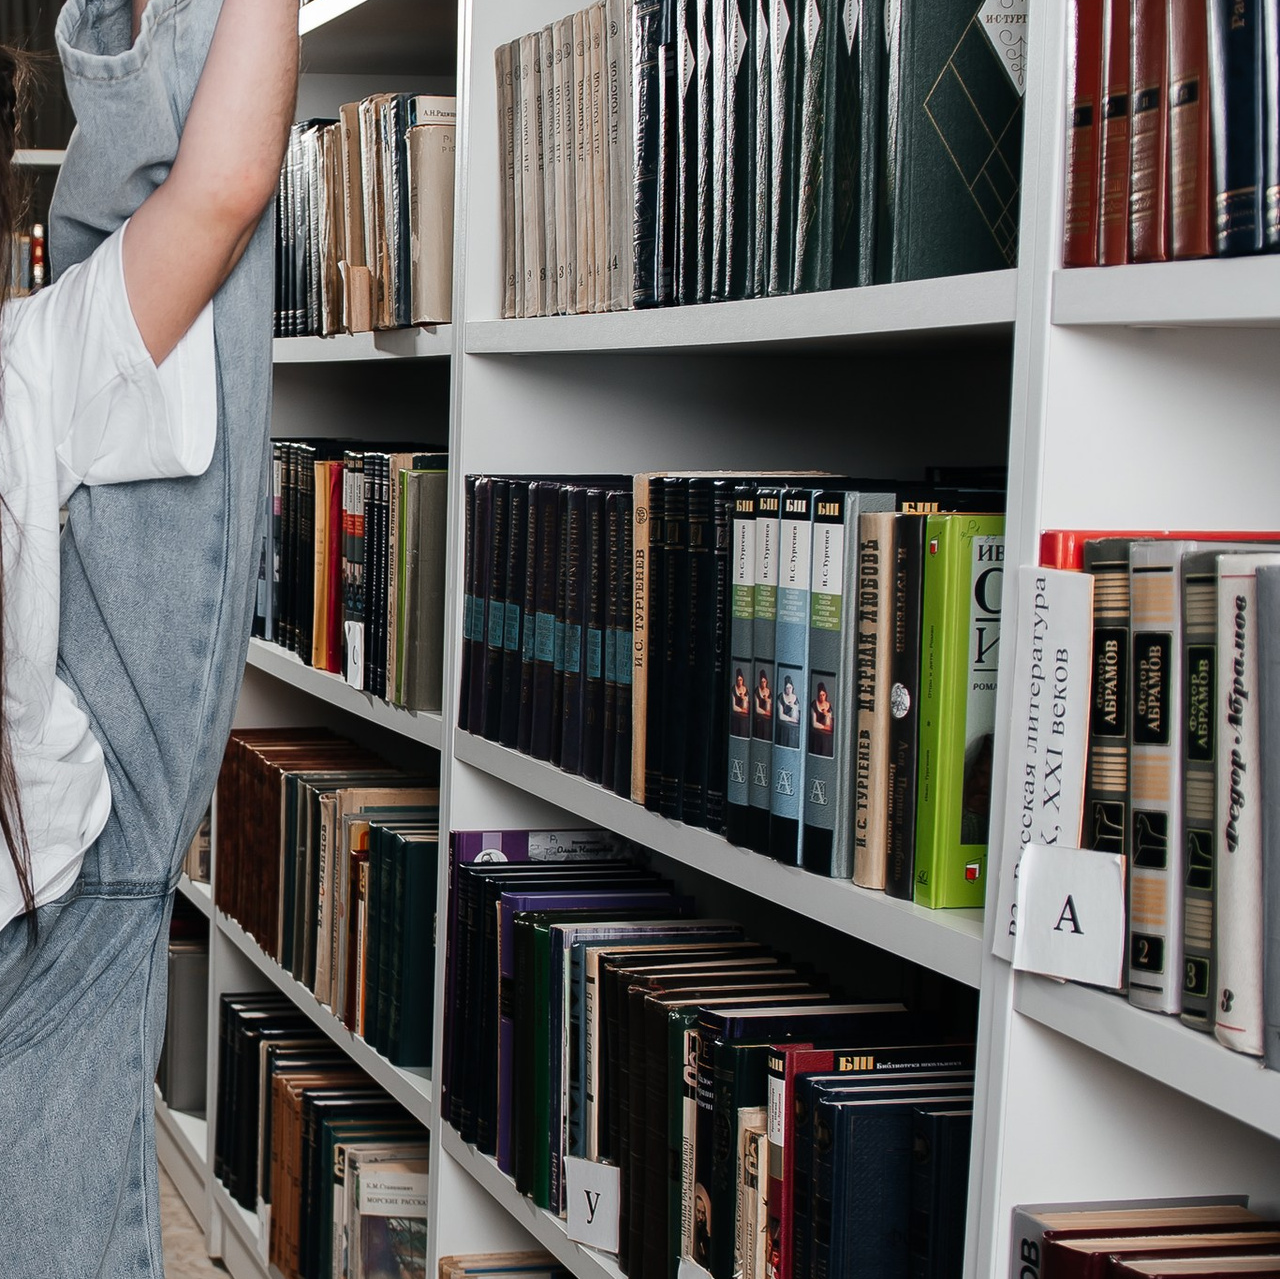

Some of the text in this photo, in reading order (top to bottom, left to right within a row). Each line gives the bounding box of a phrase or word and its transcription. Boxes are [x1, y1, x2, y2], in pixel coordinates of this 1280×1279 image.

[610, 60, 618, 116] ТОЛСТОЙ
[736, 500, 754, 512] БШ
[759, 498, 778, 511] БШ
[785, 499, 806, 513] БШ
[817, 502, 840, 516] БШ
[902, 502, 938, 513] БШ
[978, 544, 1004, 562] ИВ
[634, 549, 645, 631] ТУРГЕНЕВ
[715, 562, 724, 635] ТУРГЕНЕВ
[896, 570, 907, 652] ТУРГЕНЕВ
[858, 632, 877, 712] ПЕРВАЯ
[1026, 577, 1048, 753] литература
[1104, 639, 1119, 725] АБРАМОВ
[1146, 645, 1162, 732] АБРАМОВ
[1197, 659, 1211, 748] АБРАМОВ
[1041, 648, 1070, 814] XXI веков
[1225, 595, 1248, 853] Федор Абрамов
[857, 730, 870, 810] ТУРГЕНЕВ
[1054, 895, 1084, 935] А
[1138, 939, 1150, 964] 2
[1186, 962, 1198, 987] 3
[1220, 989, 1235, 1012] 3
[839, 1056, 874, 1072] БШ
[367, 1196, 398, 1204] МОРСКИЕ
[584, 1189, 600, 1224] У
